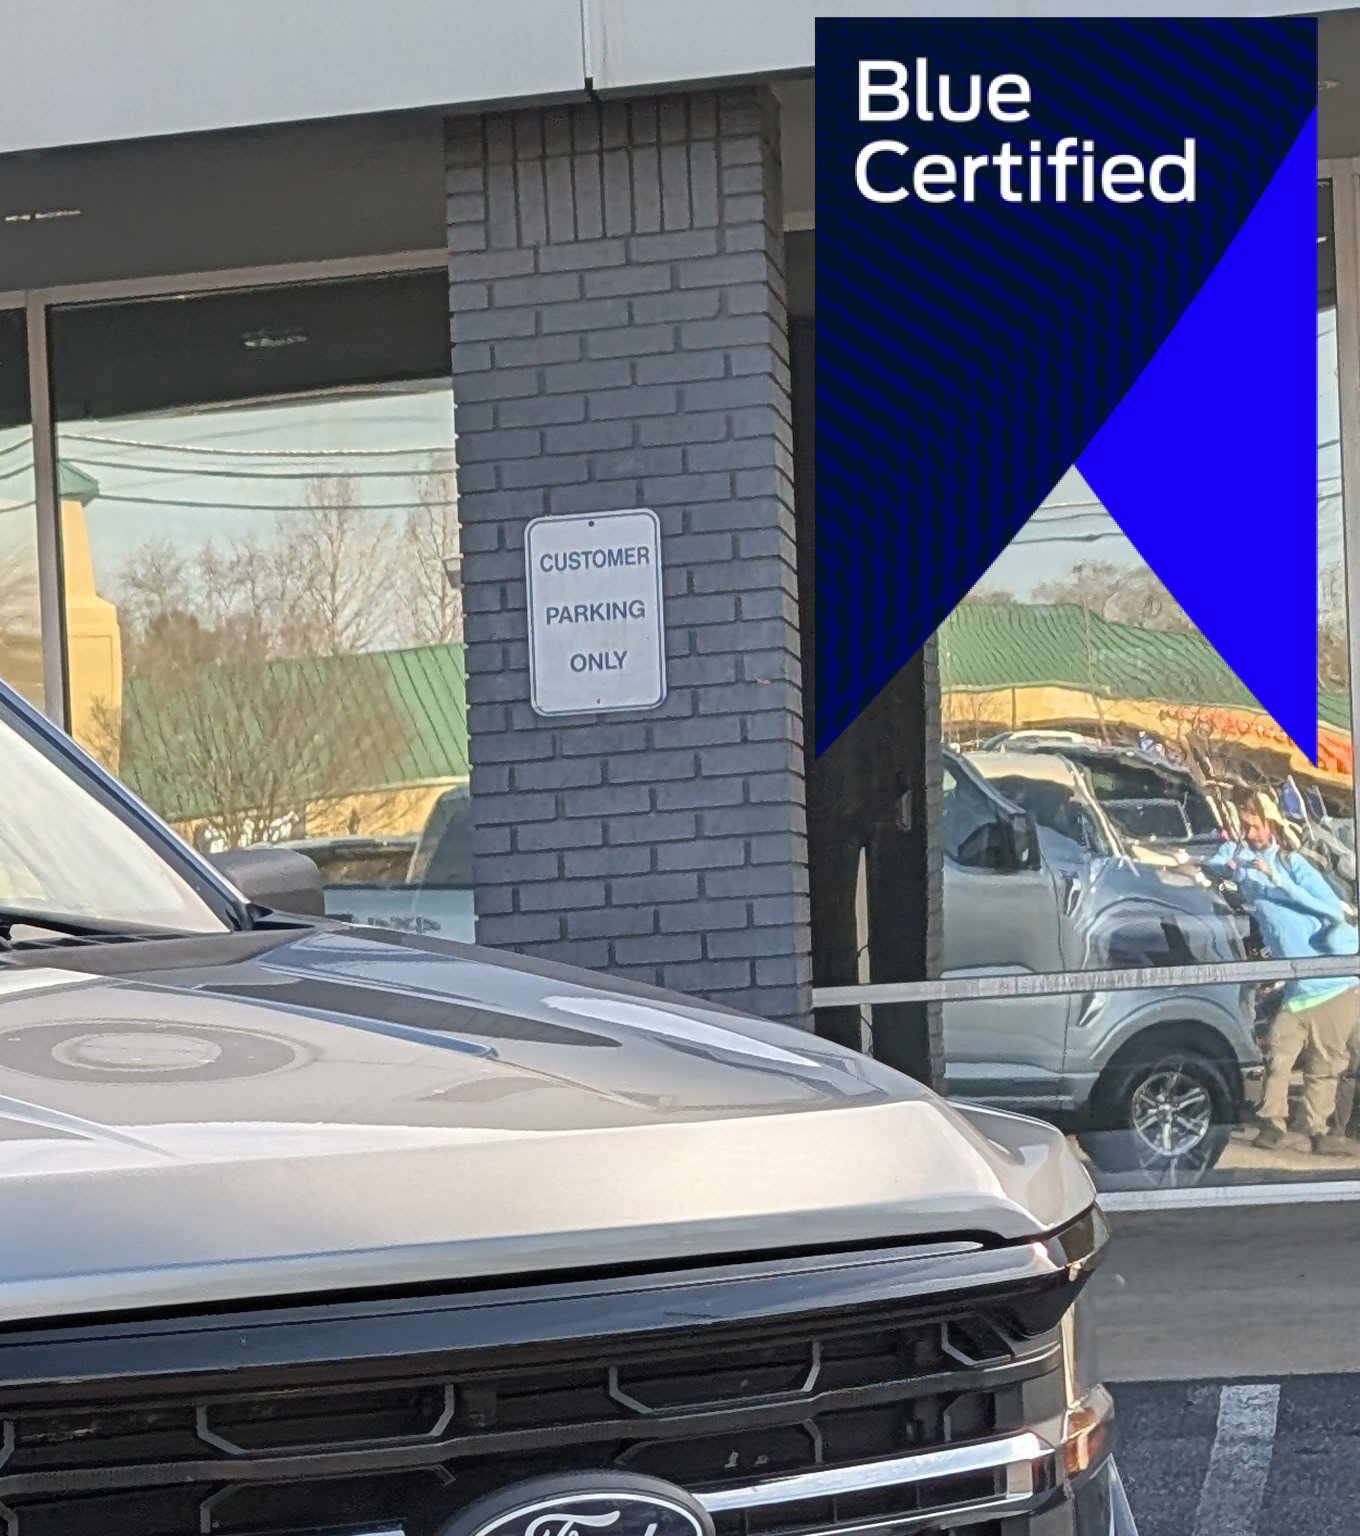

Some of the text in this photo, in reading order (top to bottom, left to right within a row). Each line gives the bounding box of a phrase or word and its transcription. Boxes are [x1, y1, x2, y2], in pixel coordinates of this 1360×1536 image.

[539, 546, 650, 573] CUSTOMER
[546, 599, 646, 625] PARKING
[569, 650, 628, 673] ONLY
